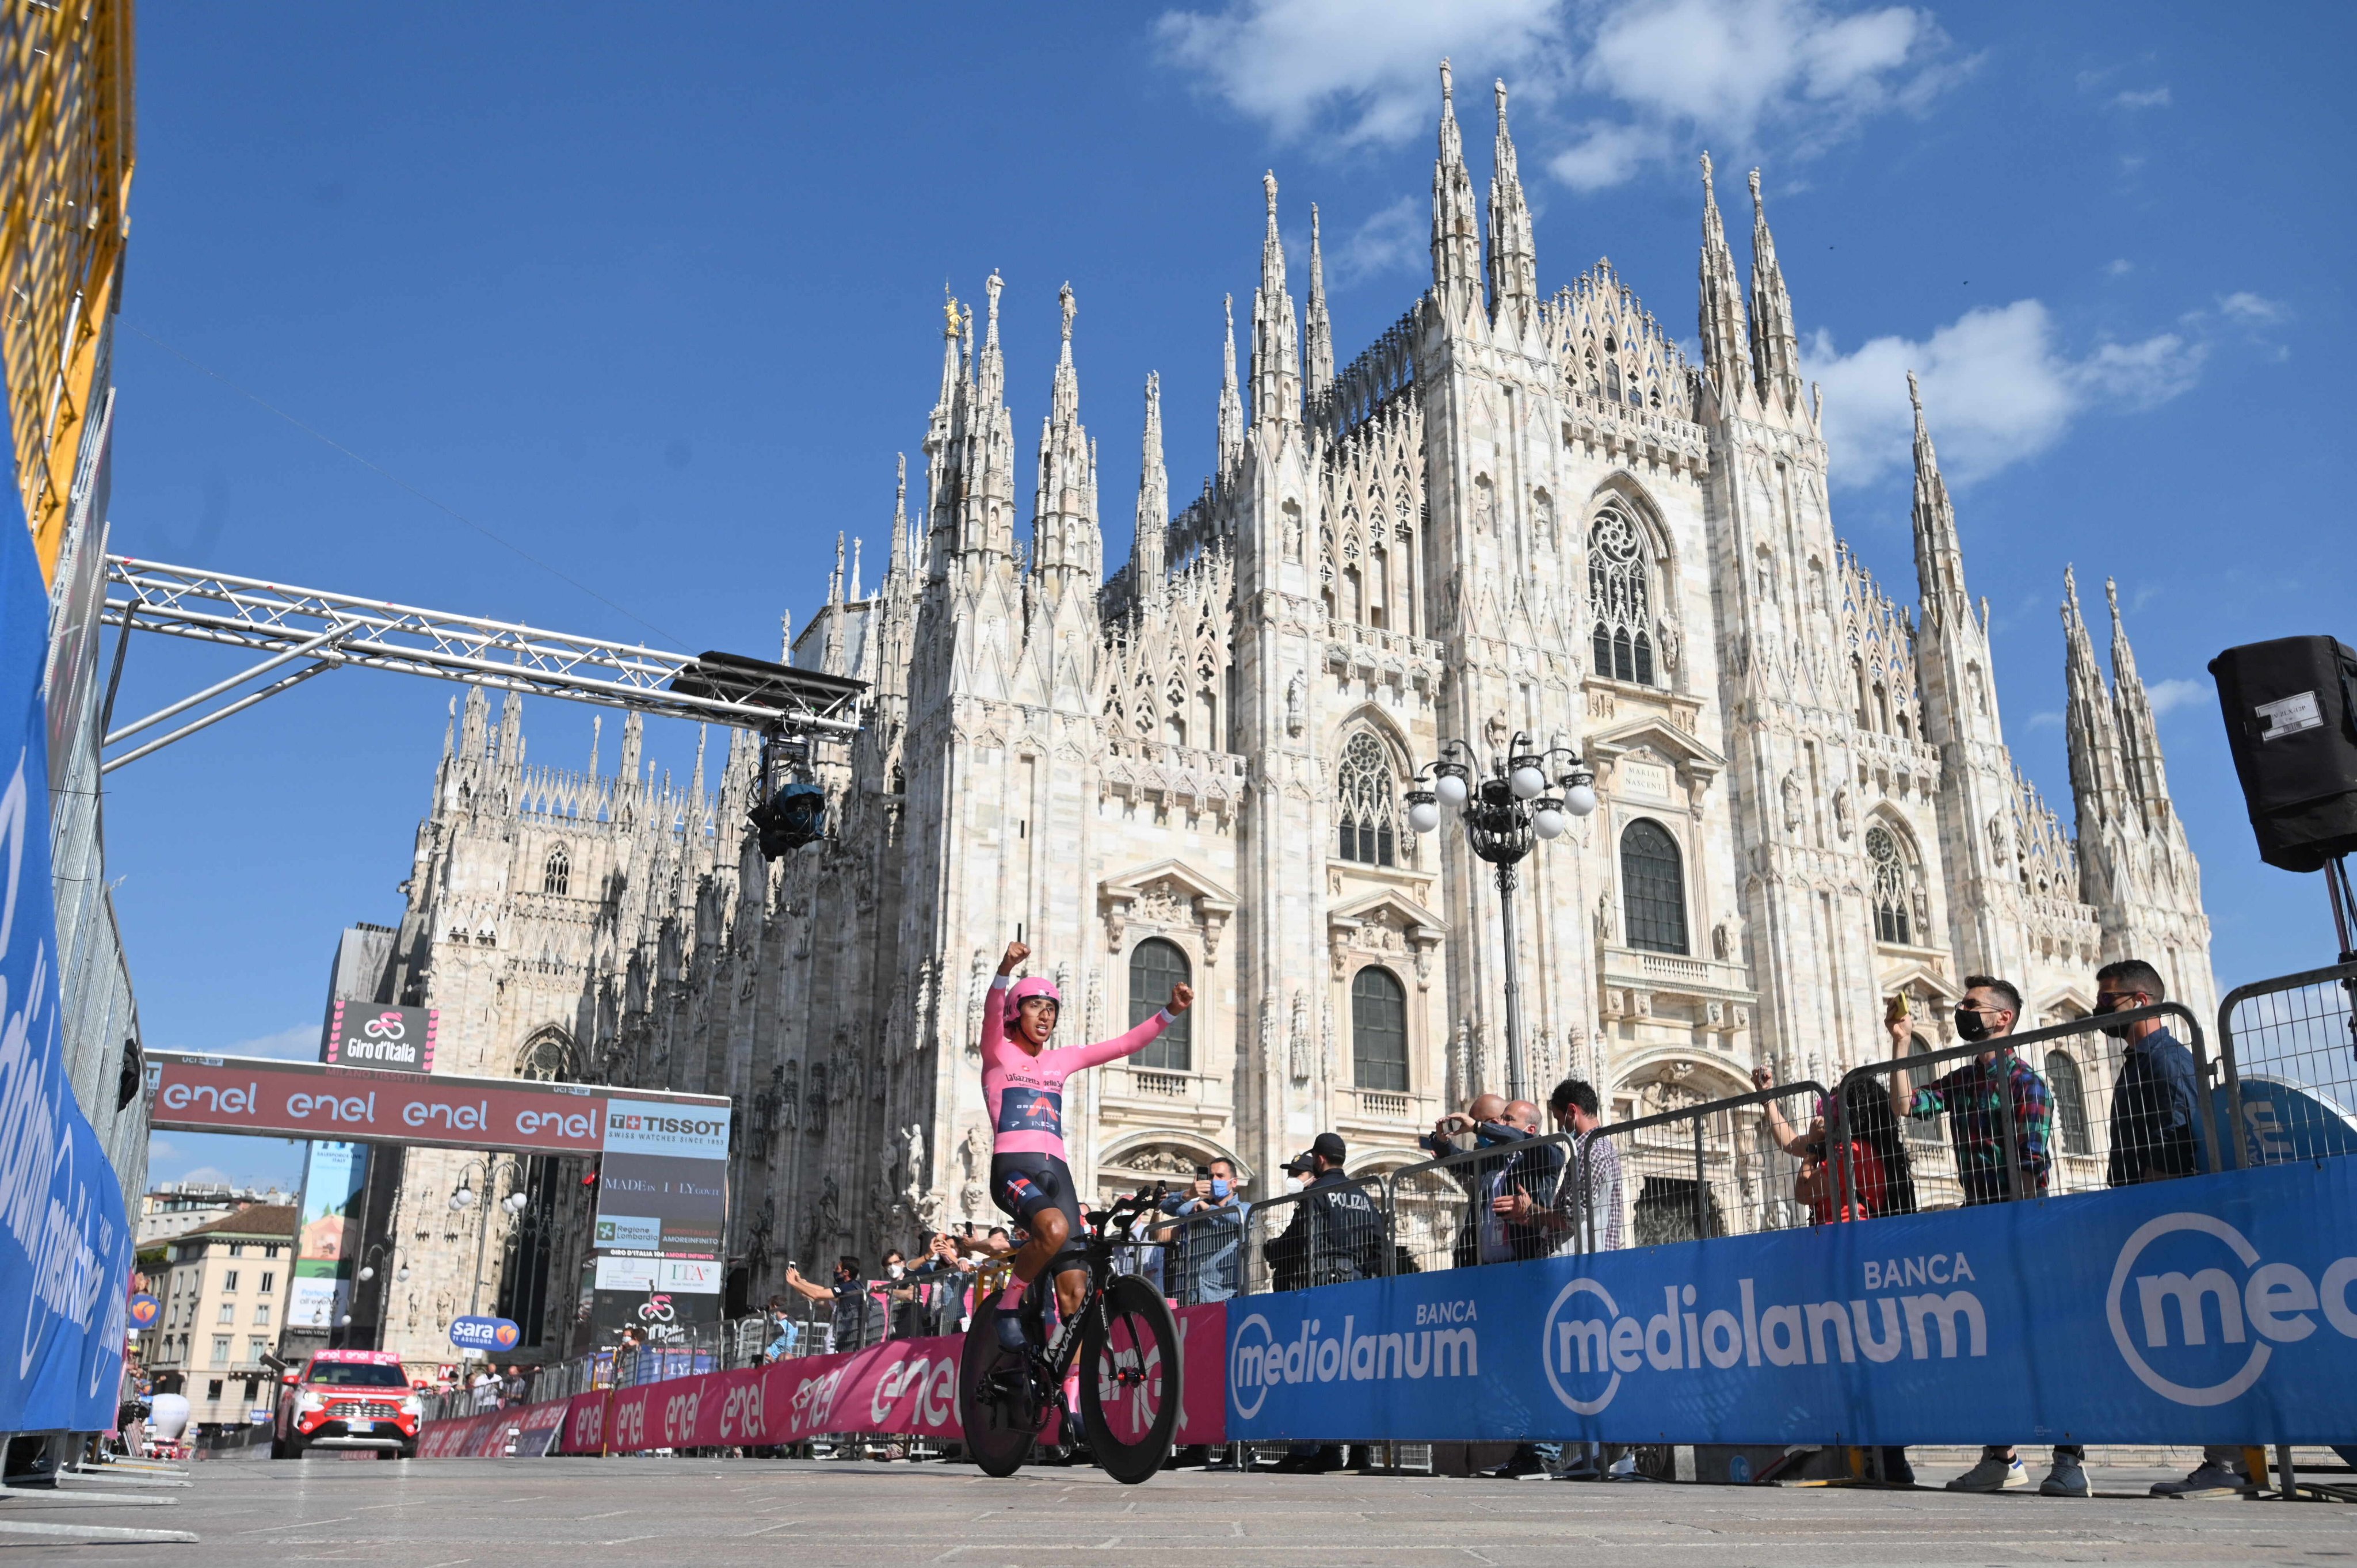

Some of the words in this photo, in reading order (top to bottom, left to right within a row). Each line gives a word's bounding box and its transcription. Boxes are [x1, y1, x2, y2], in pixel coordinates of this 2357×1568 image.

[1628, 766, 1660, 779] MARIAE
[1625, 777, 1665, 791] NASCENTI
[347, 1037, 375, 1059] Giro
[375, 1040, 415, 1063] d'Italia
[326, 1067, 371, 1078] MILANO
[373, 1070, 412, 1082] TISSOT
[163, 1082, 257, 1115] enel
[287, 1091, 375, 1123] enel
[403, 1100, 487, 1131] enel
[516, 1109, 597, 1139] enel
[643, 1116, 725, 1136] TISSOT
[1031, 1120, 1056, 1131] INEOS
[608, 1131, 635, 1139] SWISS
[639, 1134, 676, 1142] WATCHES
[1328, 1192, 1371, 1212] POLIZIA
[617, 1224, 650, 1234] Regione
[617, 1233, 658, 1241] Lombardia
[1864, 1252, 1976, 1290] BANCA
[1416, 1299, 1477, 1325] BANCA
[453, 1322, 494, 1339] sara
[1054, 1279, 1093, 1374] PINARELLO
[1557, 1277, 1987, 1374] mediolanum
[461, 1336, 492, 1344] ASSICURA
[317, 1350, 340, 1359] enel
[346, 1350, 369, 1360] enel
[374, 1352, 396, 1362] enel
[1236, 1314, 1478, 1388] mediolanum
[439, 1365, 453, 1378] M
[575, 1393, 605, 1447] enel
[617, 1388, 649, 1446] enel
[665, 1379, 706, 1443] enel
[720, 1373, 768, 1439] enel
[791, 1359, 853, 1433] enel
